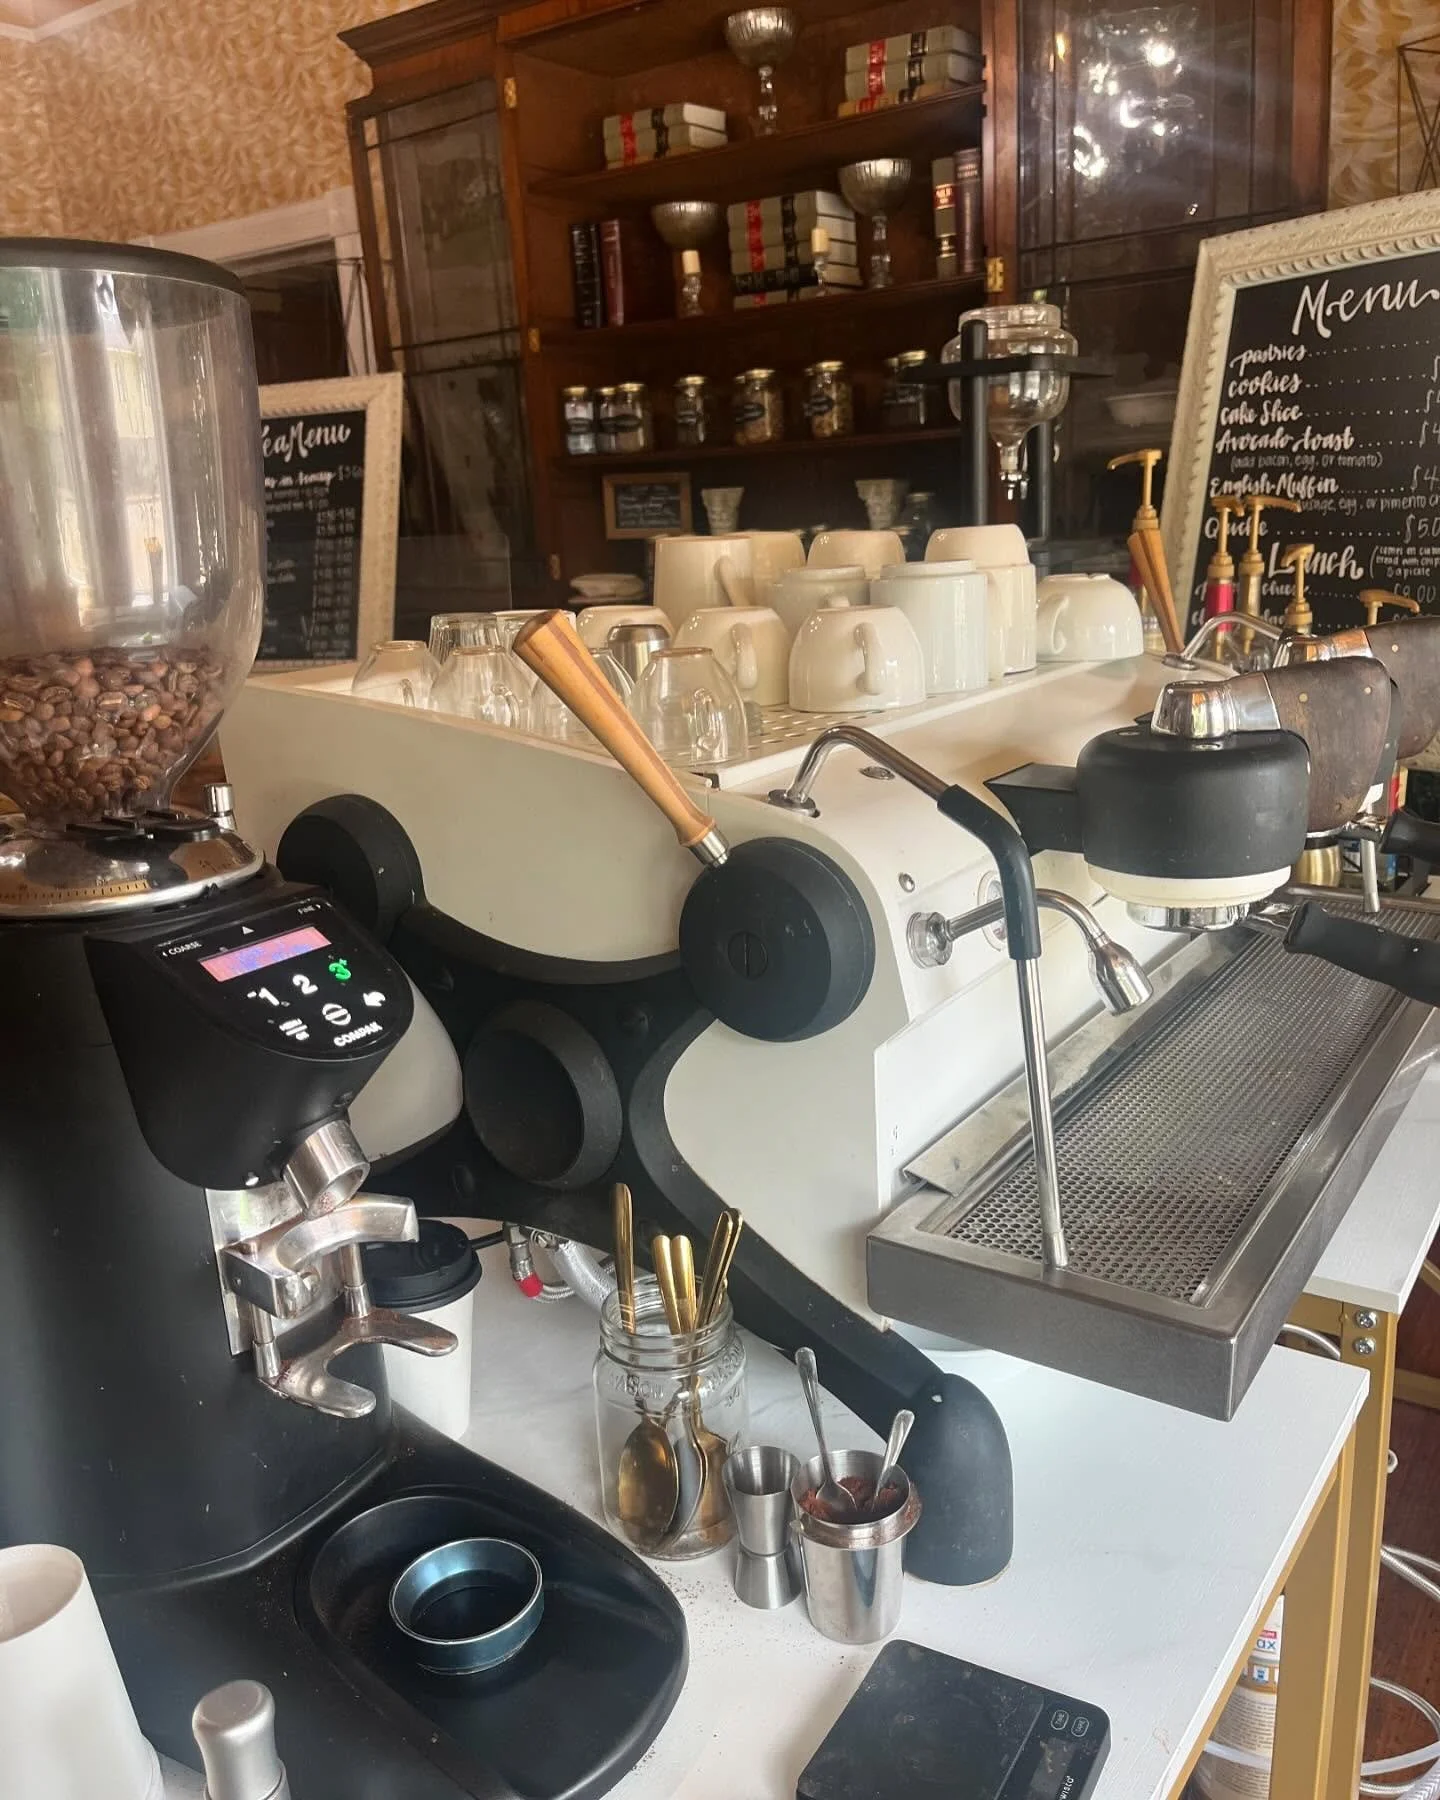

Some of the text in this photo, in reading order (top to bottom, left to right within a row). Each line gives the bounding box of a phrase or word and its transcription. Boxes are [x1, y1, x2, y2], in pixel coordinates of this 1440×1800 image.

[1292, 279, 1440, 339] Menu
[1215, 426, 1295, 454] Avocado
[1322, 454, 1335, 467] or
[1210, 474, 1277, 498] English
[1275, 472, 1339, 500] Muffin
[292, 974, 319, 995] 2
[333, 1021, 384, 1047] COMPAK
